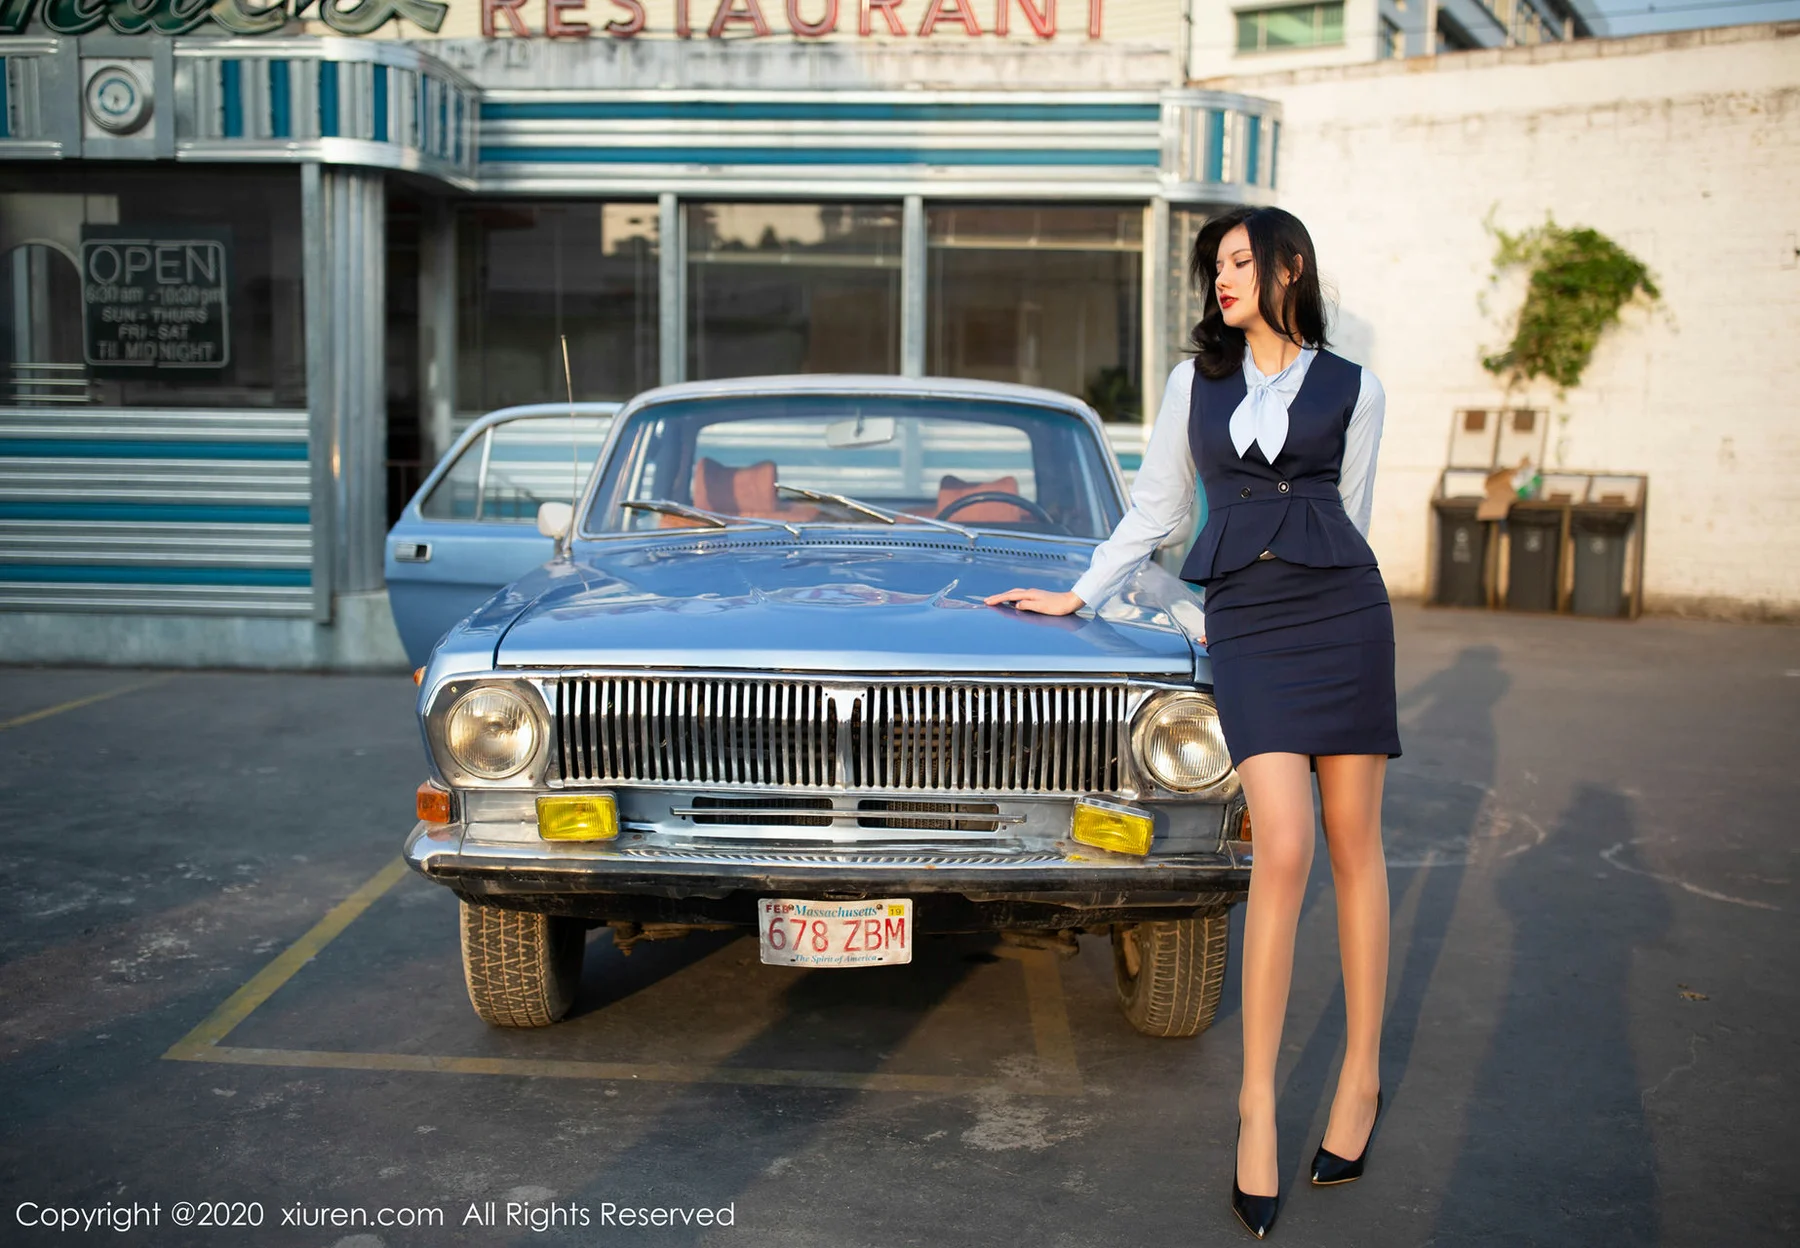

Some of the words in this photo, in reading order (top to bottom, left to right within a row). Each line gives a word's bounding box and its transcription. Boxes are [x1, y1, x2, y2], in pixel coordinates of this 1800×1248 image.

[89, 245, 215, 284] OPEN
[102, 306, 137, 322] SUN
[152, 306, 208, 323] THURS
[765, 904, 790, 914] FEB
[794, 904, 877, 918] Massachusetts
[769, 917, 829, 953] 678
[843, 917, 905, 952] ZBM
[795, 954, 808, 962] The
[811, 955, 833, 964] Spirit
[834, 955, 843, 964] of
[844, 955, 877, 963] America
